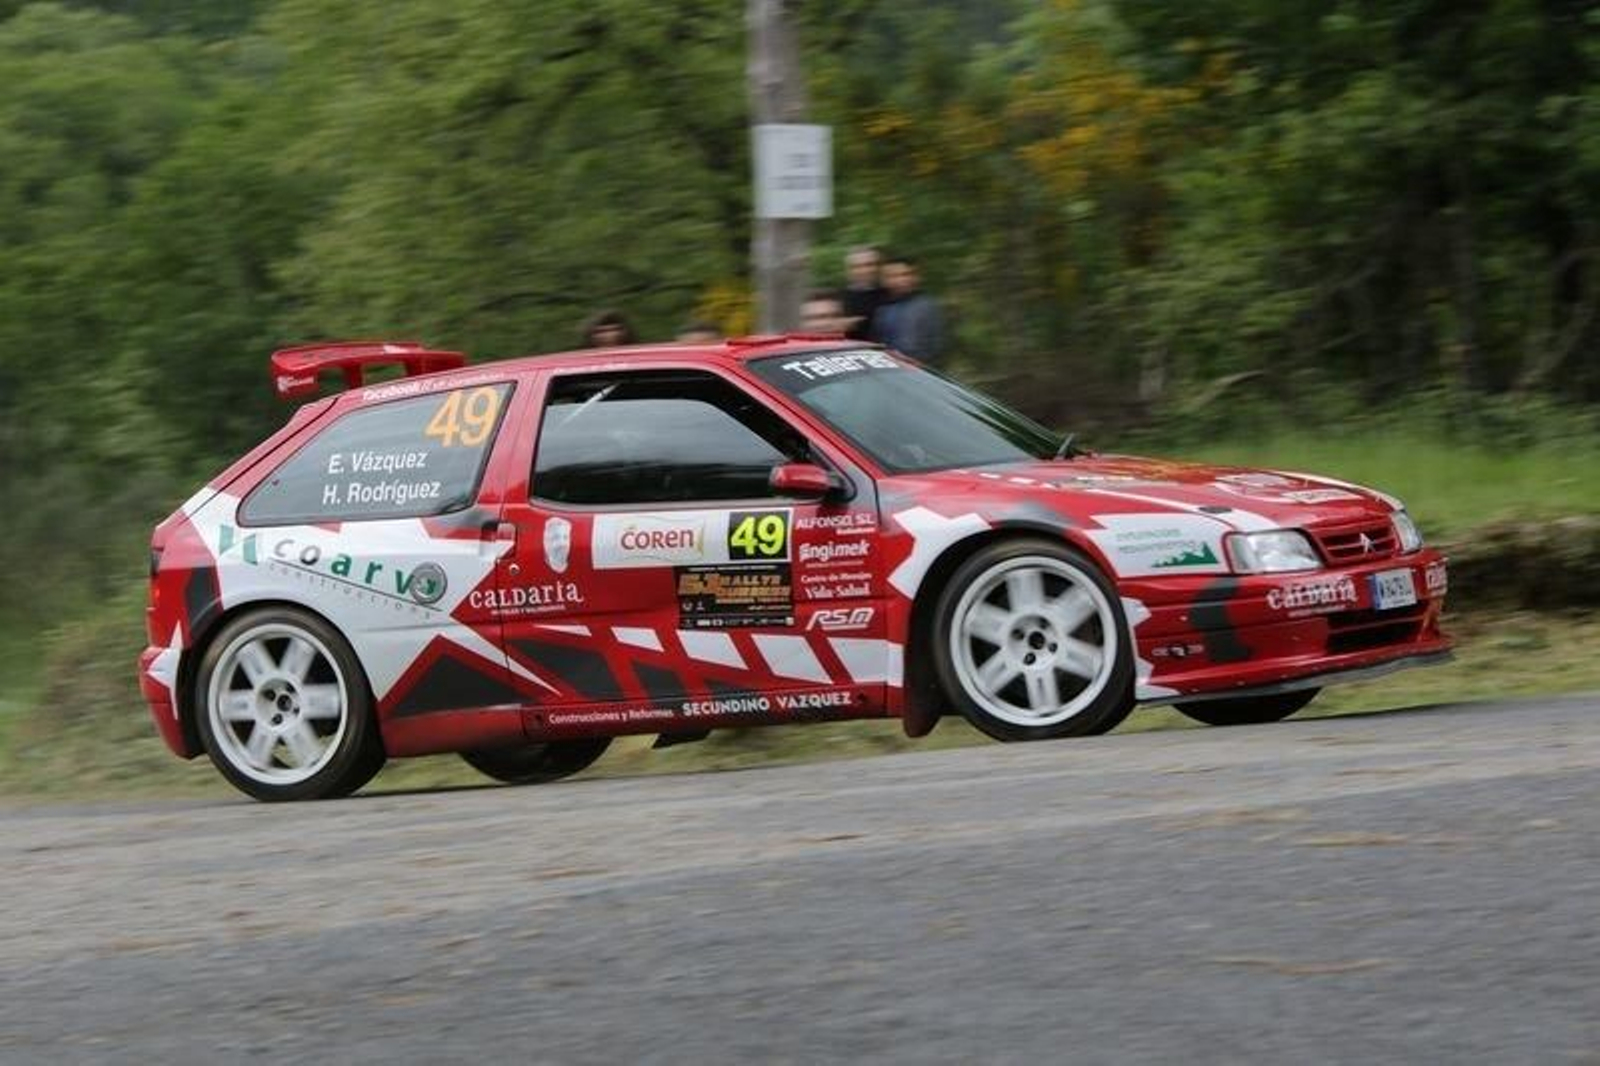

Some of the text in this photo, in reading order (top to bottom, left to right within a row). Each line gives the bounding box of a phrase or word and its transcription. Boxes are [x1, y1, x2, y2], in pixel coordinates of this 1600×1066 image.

[425, 387, 498, 448] 49
[328, 449, 428, 475] E. Vázquez
[322, 478, 441, 505] H. Rodríguez
[728, 514, 786, 554] 49
[682, 692, 852, 717] SECUNDINO VAZQUEZ
